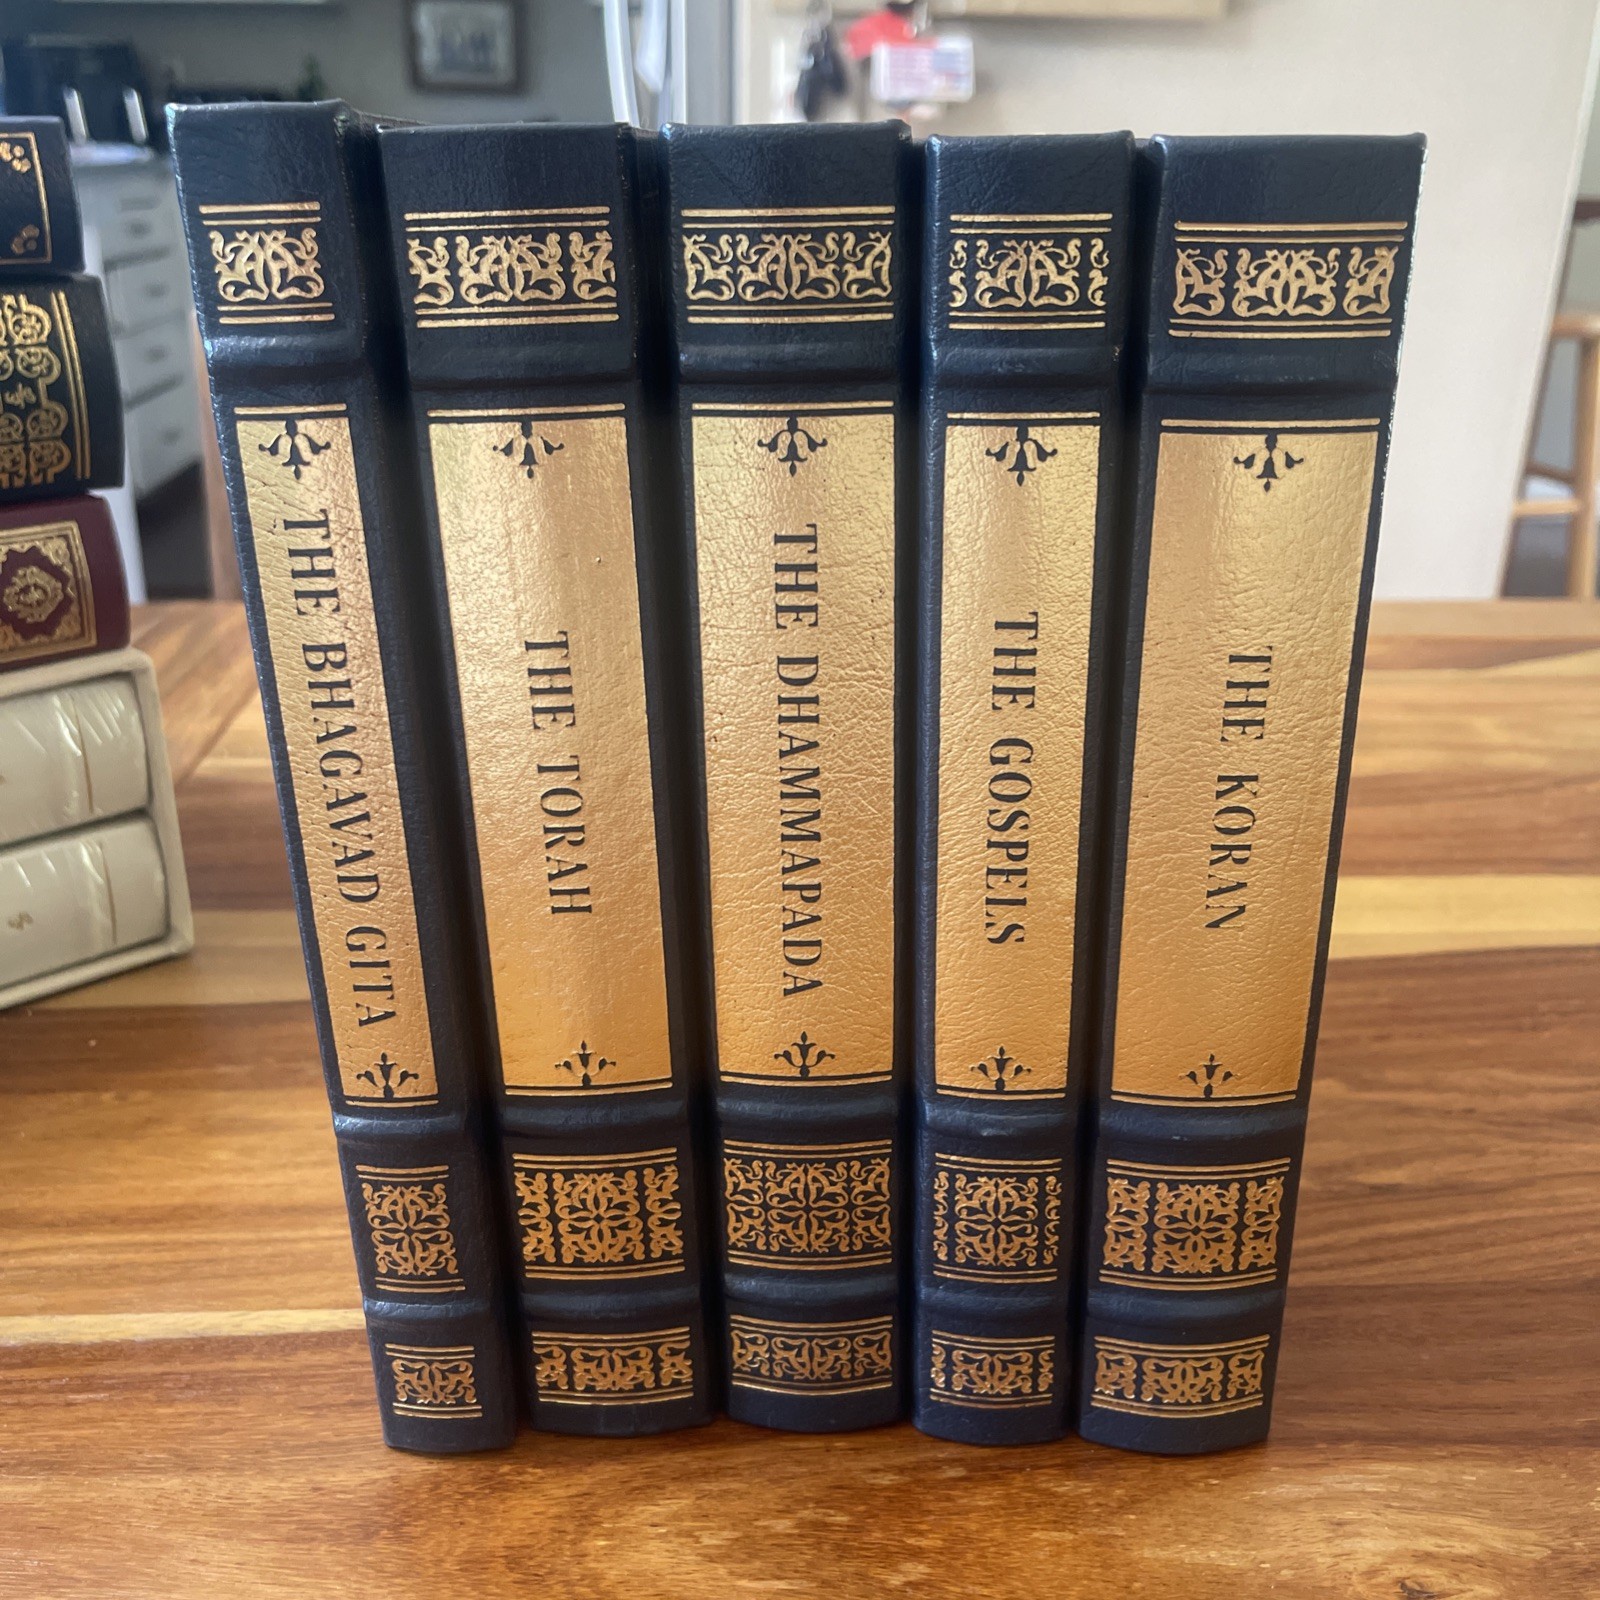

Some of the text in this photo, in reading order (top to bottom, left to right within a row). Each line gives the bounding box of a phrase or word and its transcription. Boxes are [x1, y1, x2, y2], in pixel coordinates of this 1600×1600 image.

[283, 508, 396, 1028] THE BHAGAVAD GITA
[524, 631, 592, 915] THE TORAH
[773, 523, 823, 998] THE DHAMMAPADA
[984, 611, 1039, 945] THE GOSPELS
[1204, 645, 1273, 930] THE KORAN
